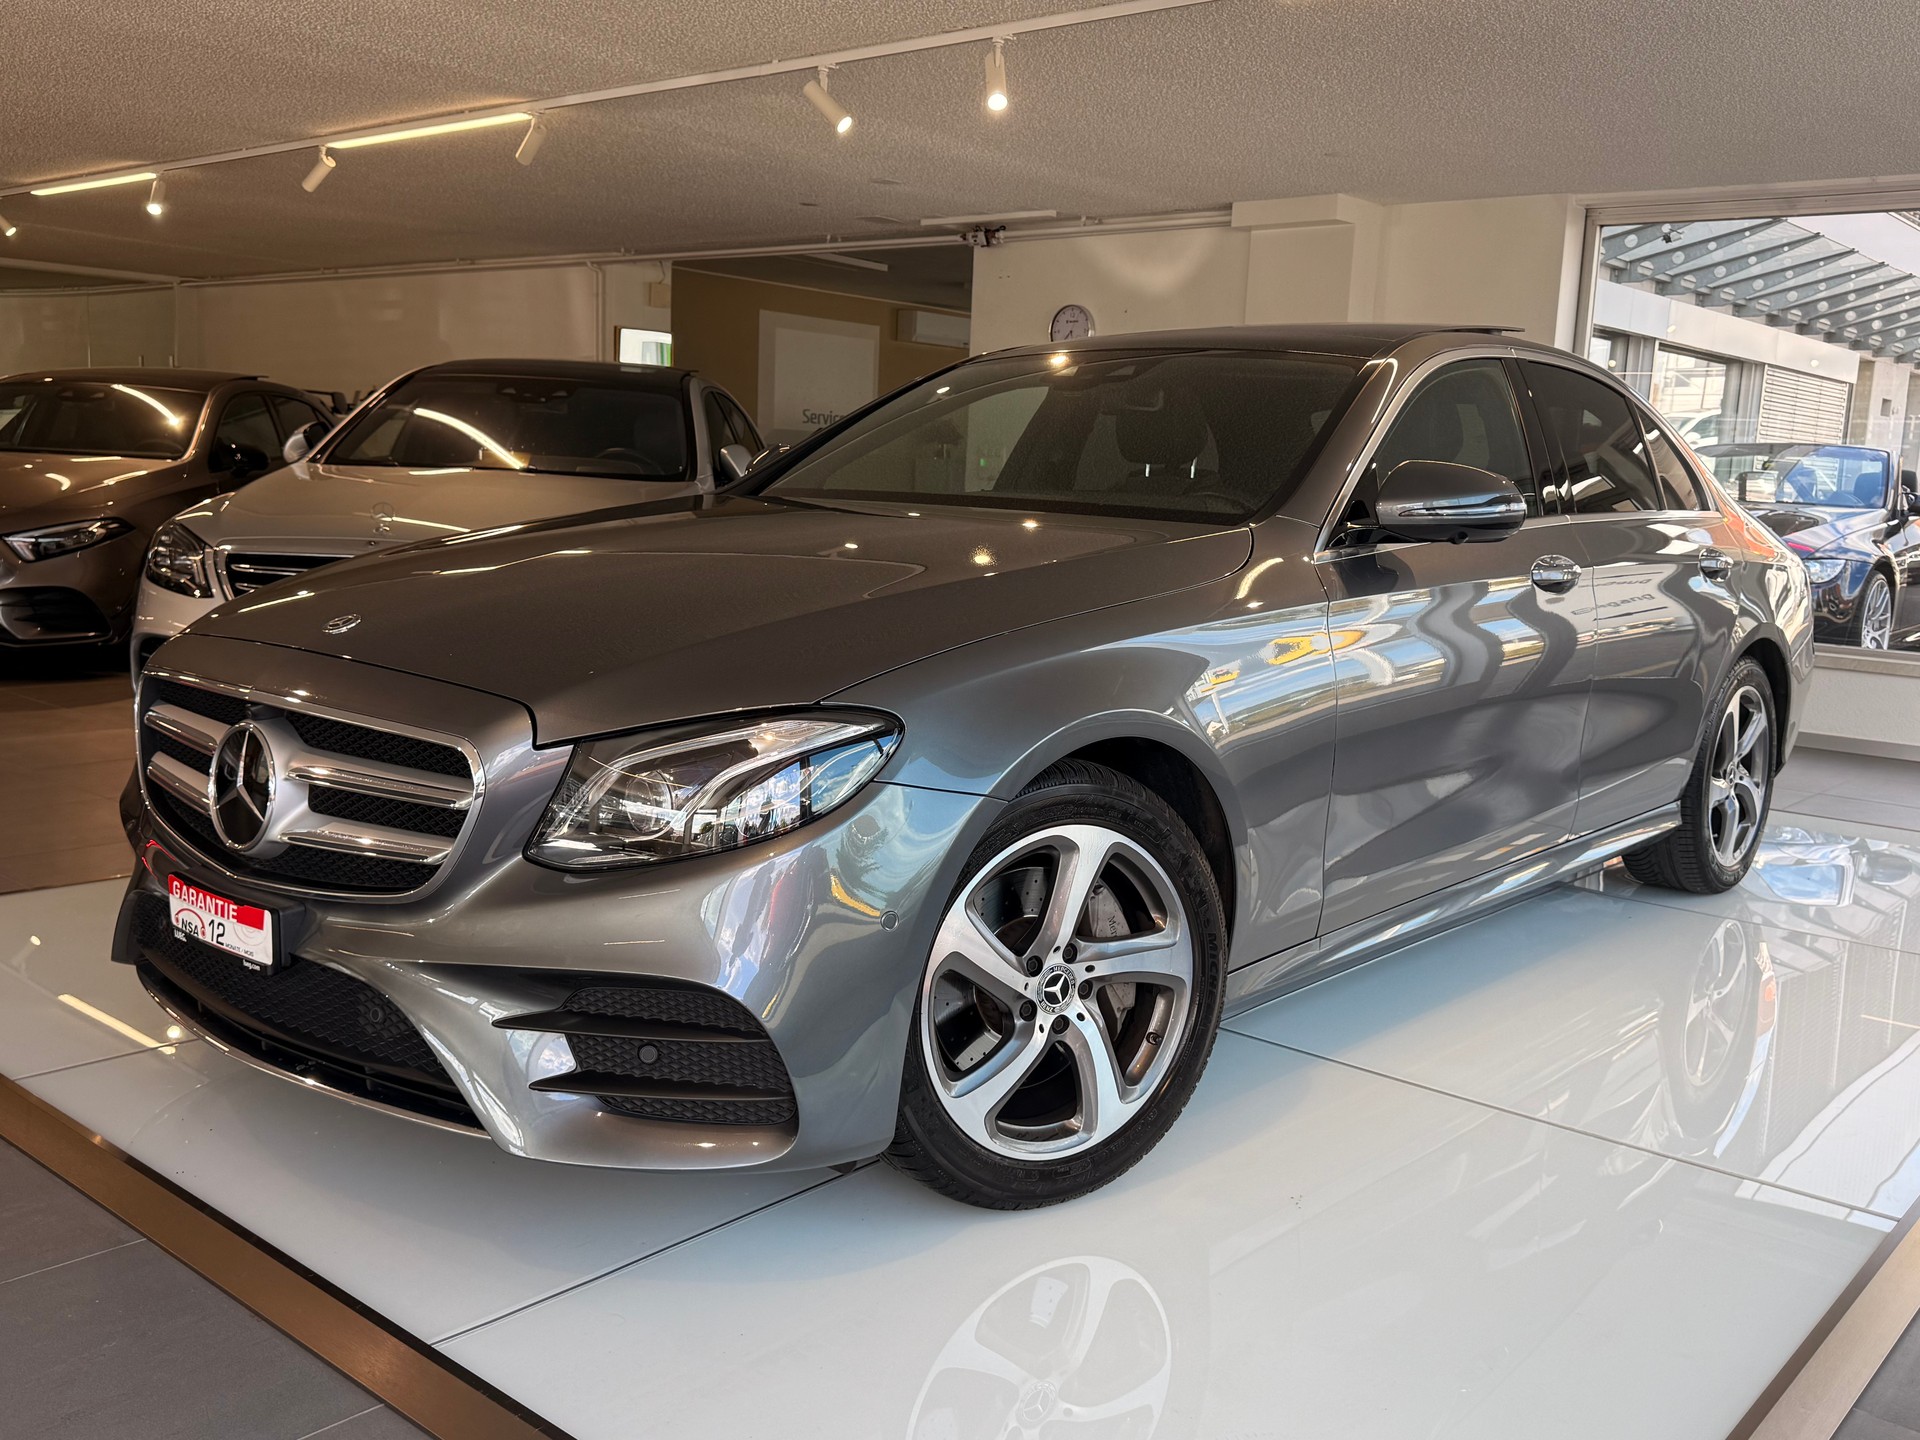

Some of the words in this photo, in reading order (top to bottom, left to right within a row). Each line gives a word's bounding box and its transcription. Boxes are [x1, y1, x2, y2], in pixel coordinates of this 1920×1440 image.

[173, 881, 238, 922] GARANTIE
[182, 918, 199, 937] NSA
[208, 919, 225, 946] 12
[1108, 915, 1117, 936] Mer
